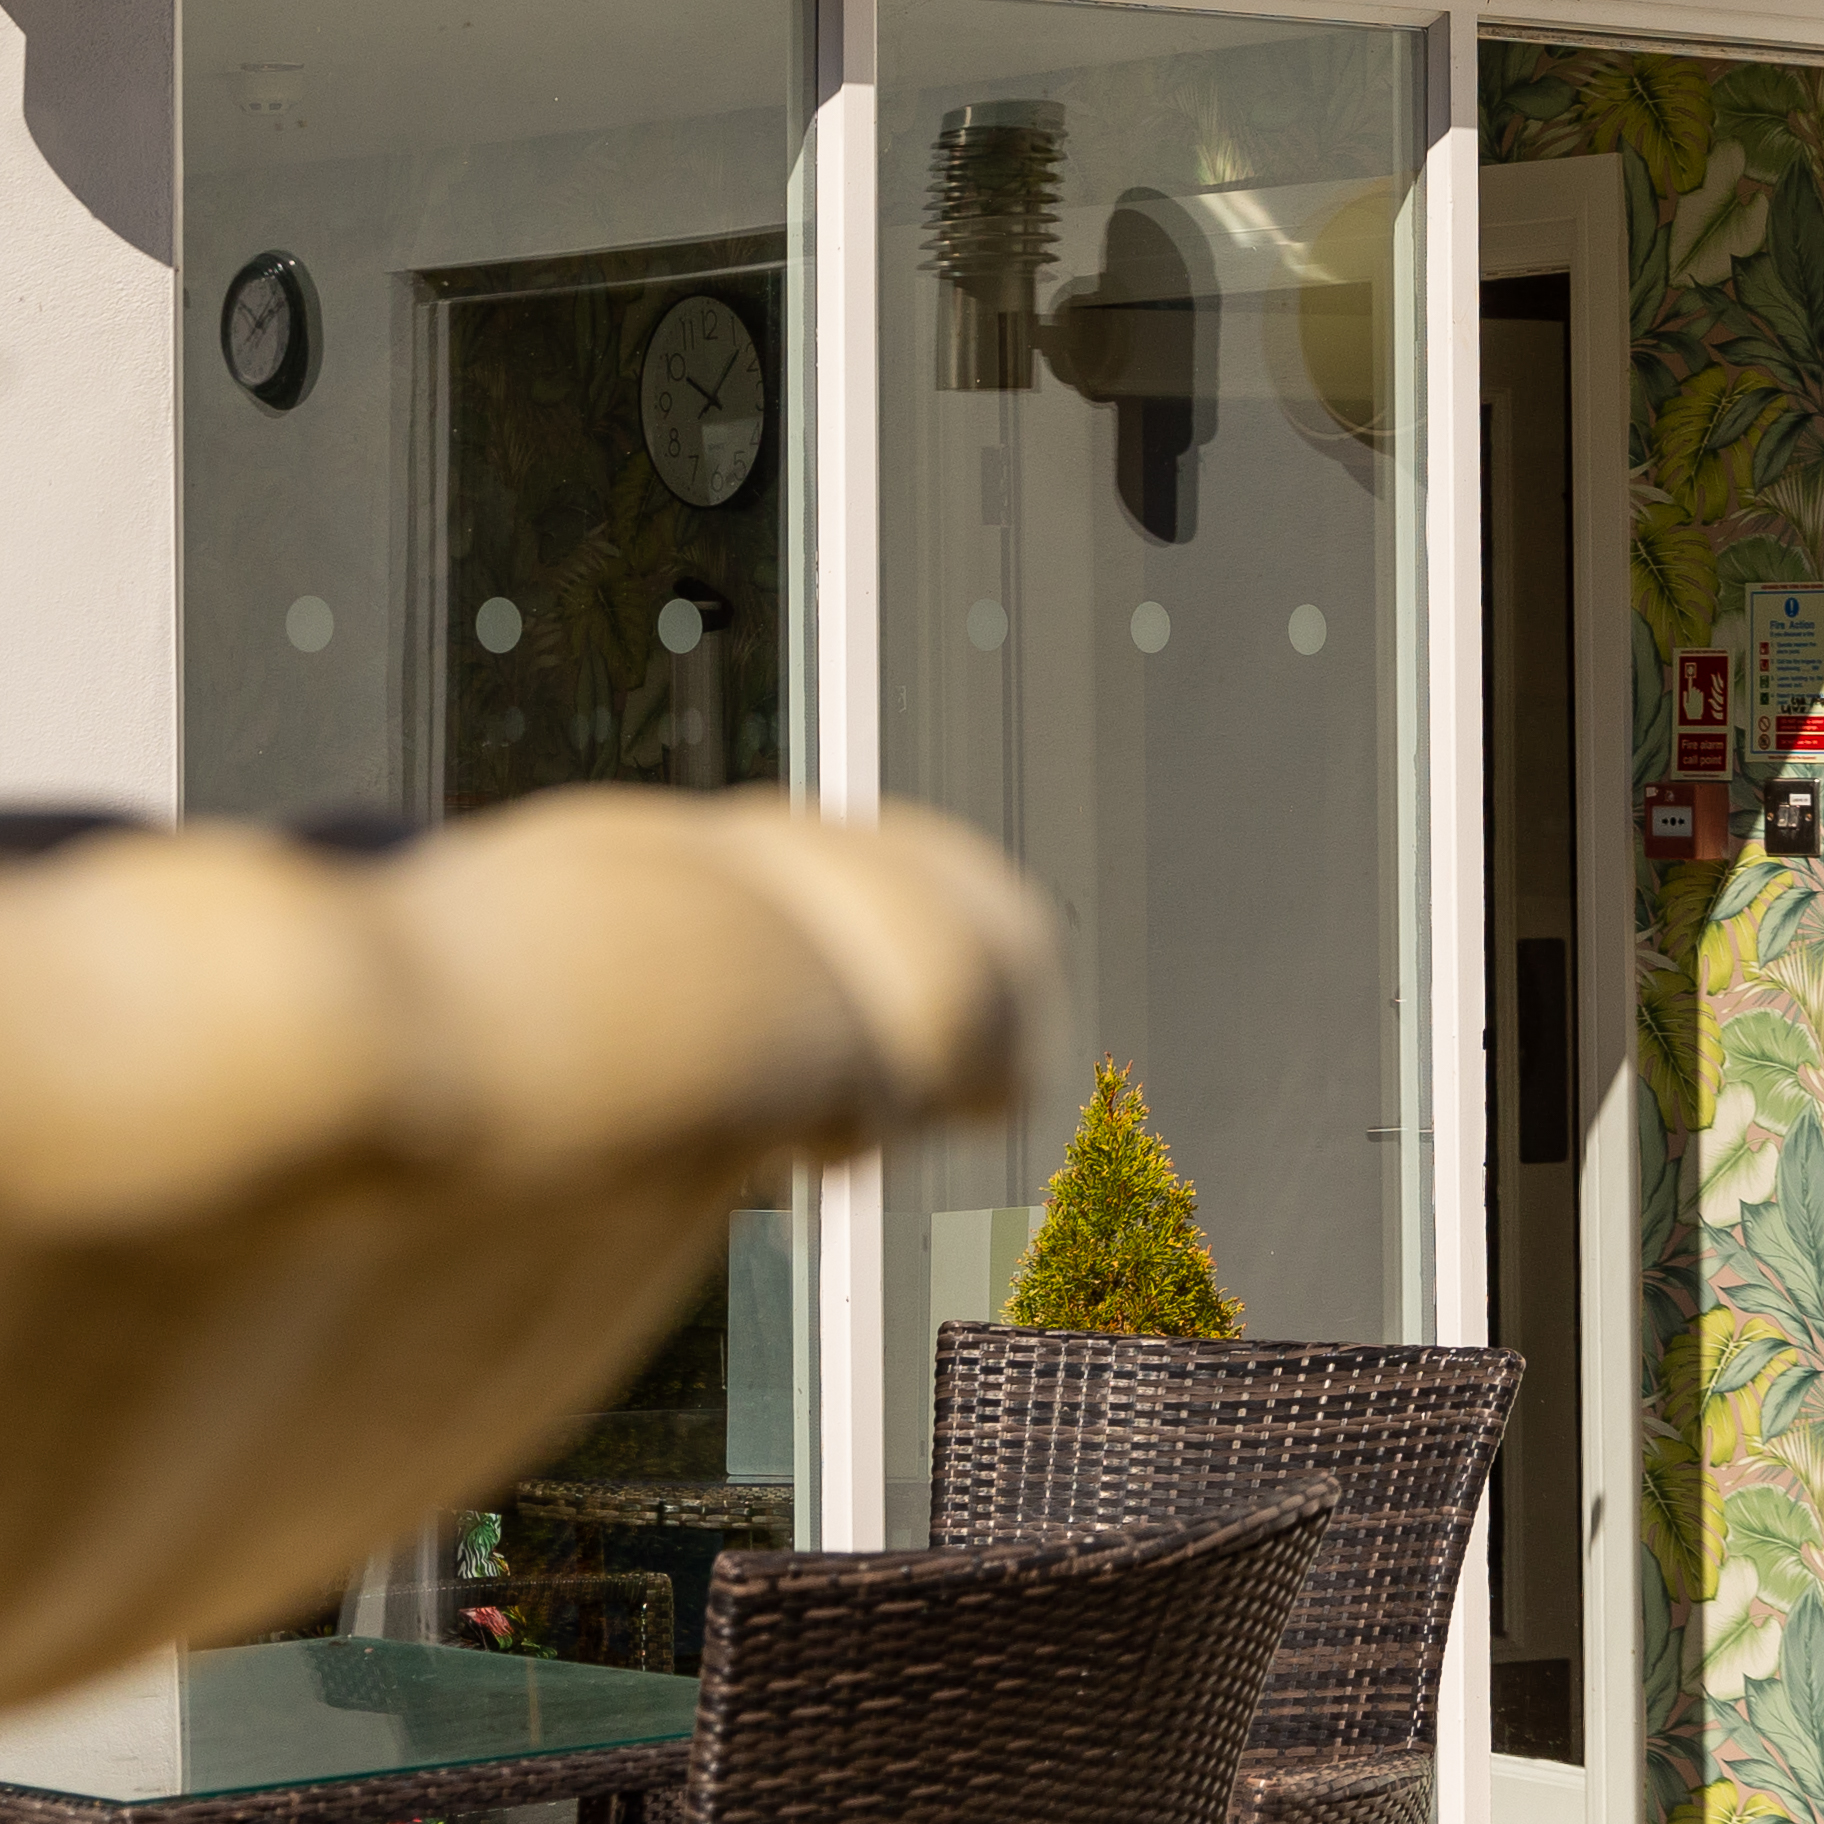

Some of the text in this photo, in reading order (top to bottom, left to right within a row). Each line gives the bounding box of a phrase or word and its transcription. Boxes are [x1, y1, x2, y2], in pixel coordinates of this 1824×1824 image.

[679, 317, 695, 350] 11
[701, 309, 718, 340] 12
[665, 352, 686, 382] 10
[745, 342, 759, 372] 2
[659, 391, 673, 420] 9
[668, 427, 681, 458] 8
[687, 455, 700, 484] 7
[710, 464, 724, 492] 6
[733, 450, 747, 481] 5
[1769, 620, 1816, 630] Fire Action
[1681, 739, 1724, 750] Fire alarm
[1682, 754, 1723, 767] call point
